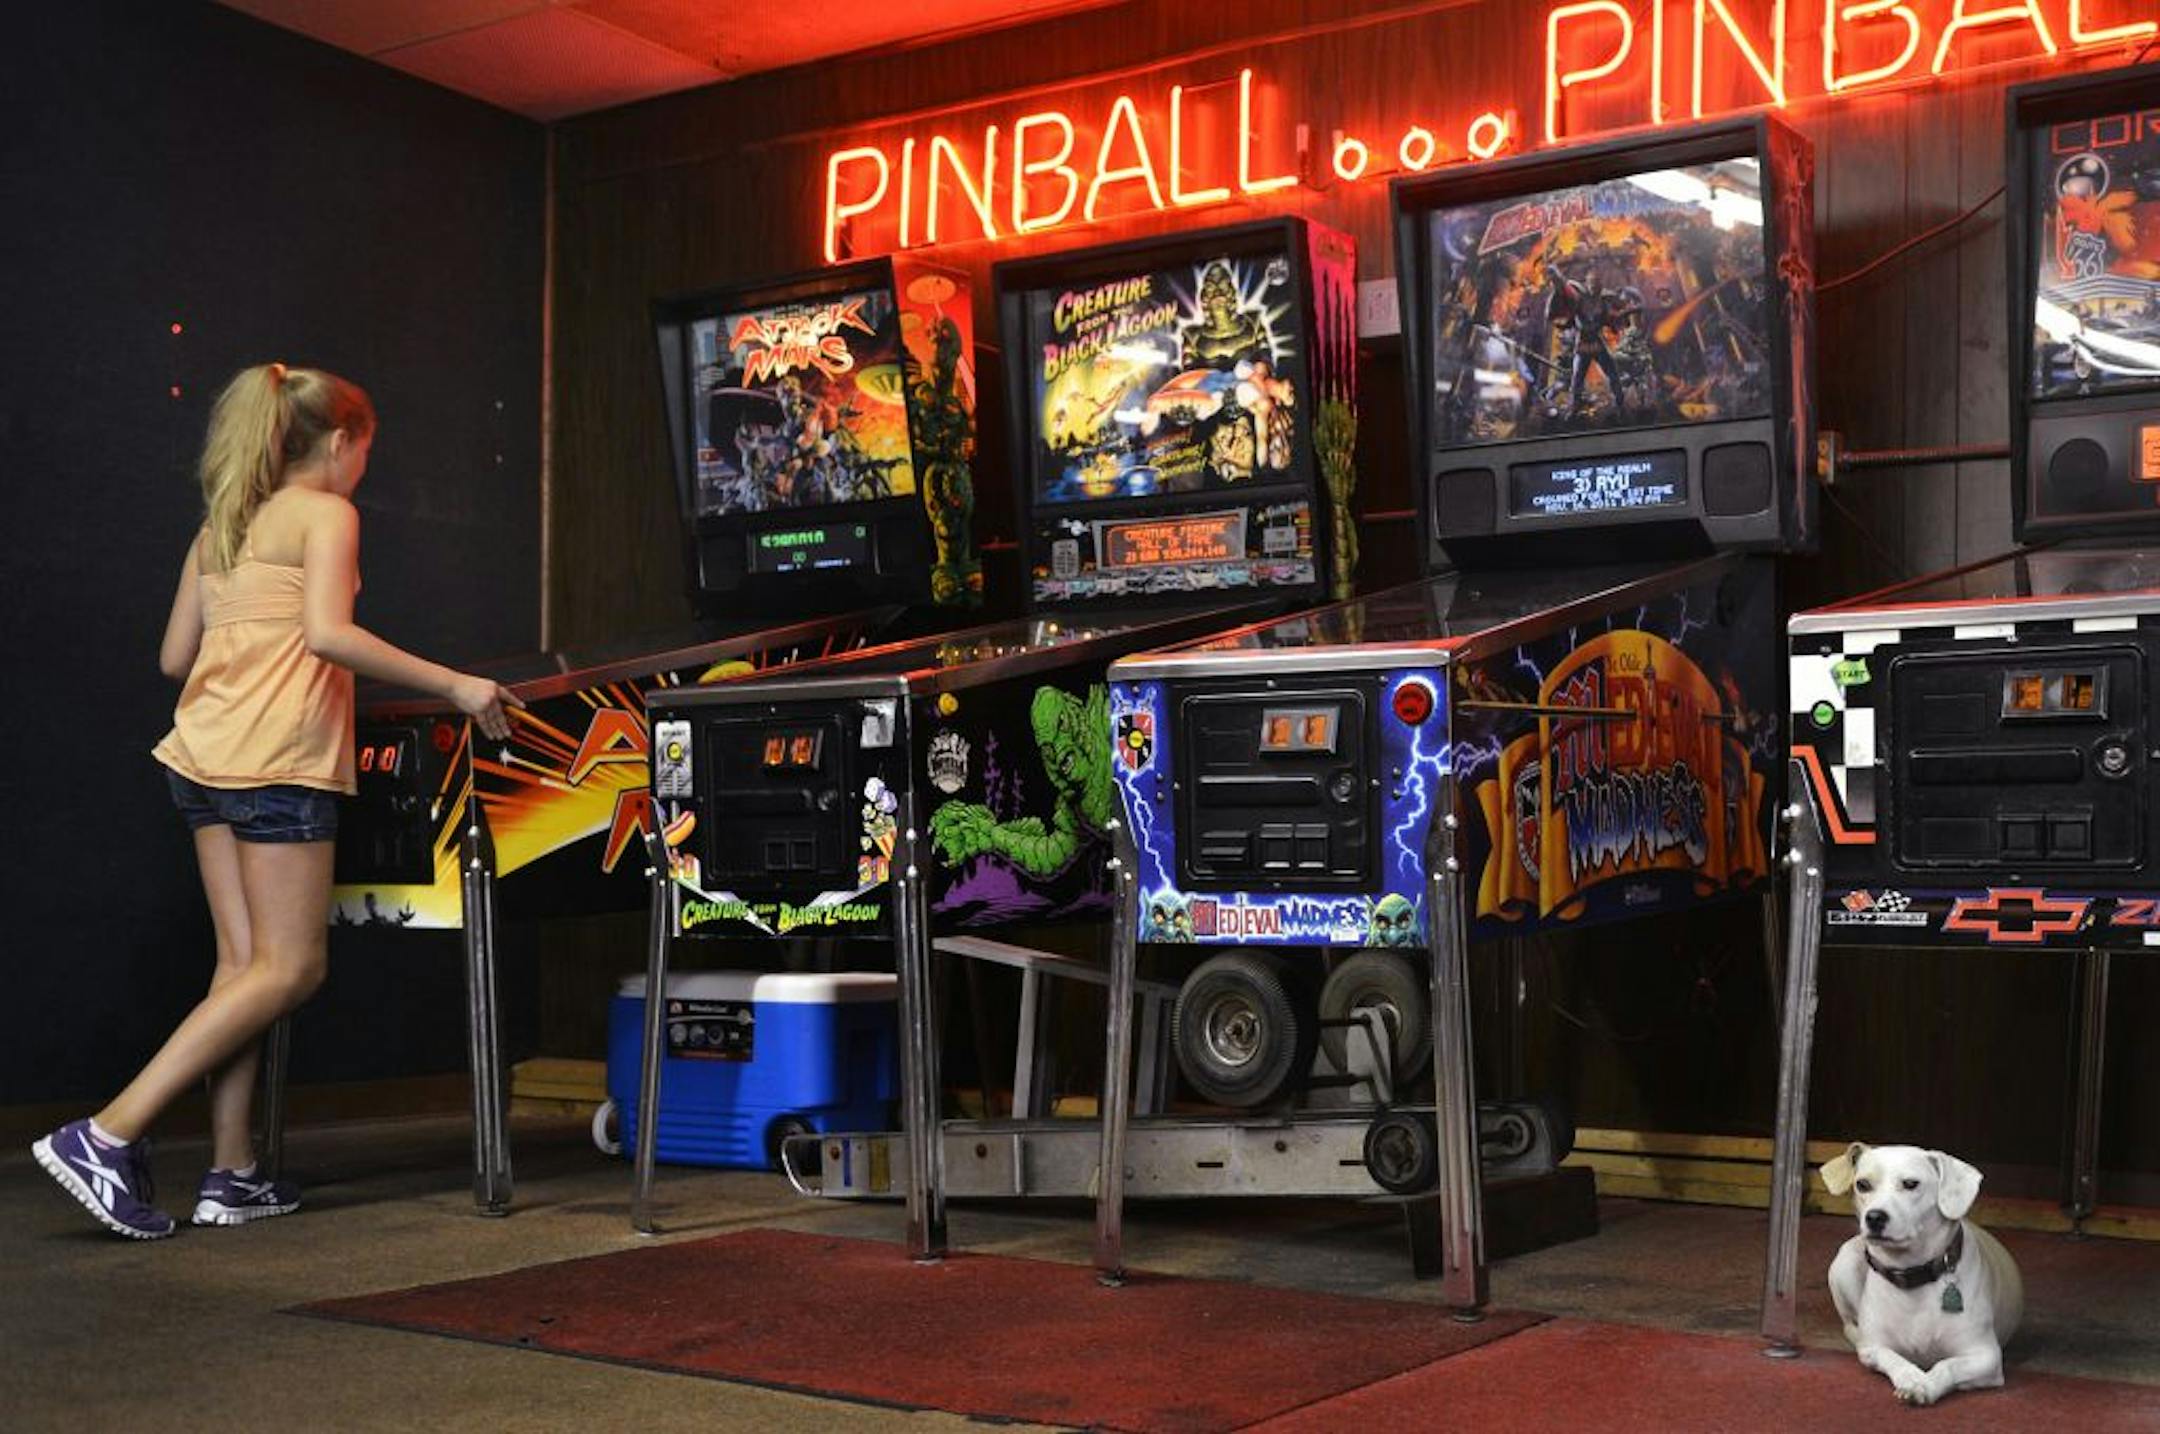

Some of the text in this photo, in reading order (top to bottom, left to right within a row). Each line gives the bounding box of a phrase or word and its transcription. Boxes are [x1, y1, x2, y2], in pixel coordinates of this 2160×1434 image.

[825, 68, 1299, 265] PINBALL
[1054, 274, 1152, 334] CREATURE
[742, 336, 854, 389] MARS
[1043, 300, 1179, 382] BLACK LAGOON
[1595, 465, 1615, 476] THE
[1617, 462, 1651, 474] REALM
[1595, 473, 1631, 493] RYU
[681, 900, 748, 930] CREATURE
[777, 901, 826, 933] BLACK
[824, 902, 881, 926] LAGOON
[1278, 898, 1371, 938] MADNESS
